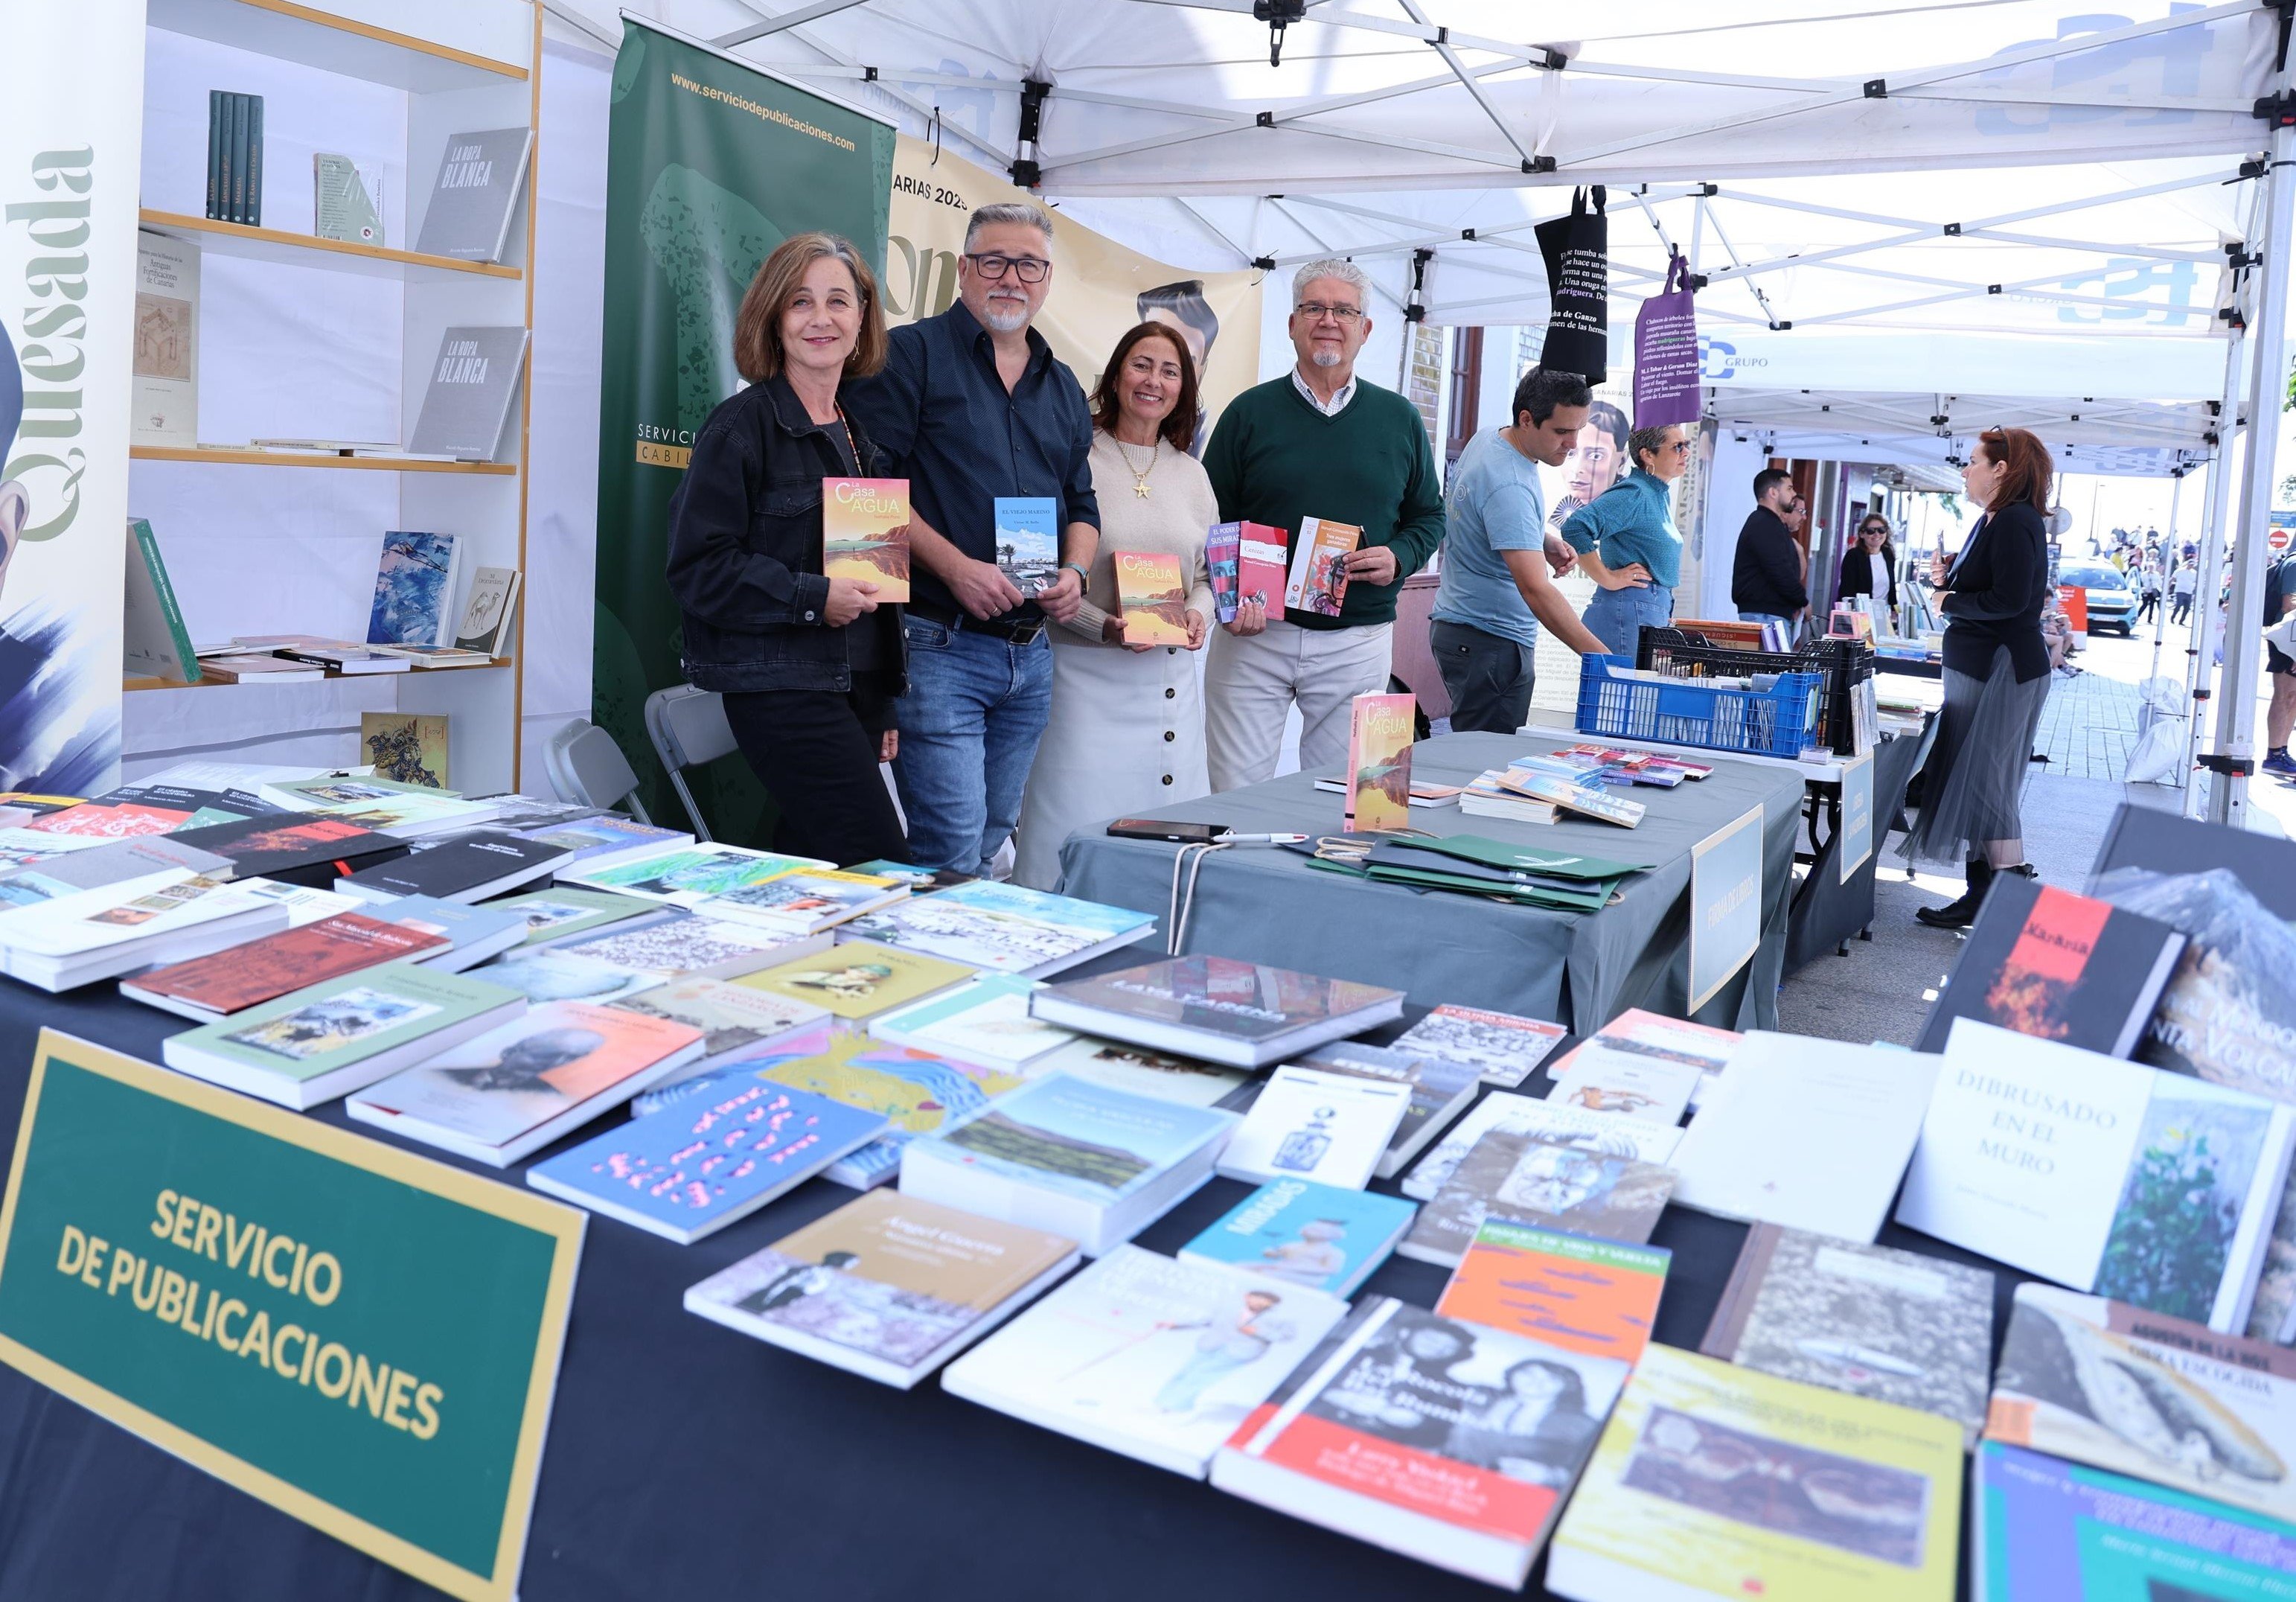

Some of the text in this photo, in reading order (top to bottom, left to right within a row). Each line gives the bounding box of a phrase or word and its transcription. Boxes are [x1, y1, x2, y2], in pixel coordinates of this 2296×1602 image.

[671, 72, 855, 152] www.serviciodepublicaciones.com
[451, 144, 482, 162] LA ROPA
[441, 161, 492, 188] BLANCA
[893, 174, 931, 200] ARIAS
[1574, 249, 1596, 258] tumba
[1565, 278, 1599, 290] Una oruga
[1574, 312, 1596, 322] Ganzo
[1578, 322, 1587, 331] las
[448, 341, 478, 356] LA ROPA
[437, 358, 488, 383] BLANCA
[1725, 357, 1768, 368] GRUPO
[639, 424, 696, 444] SERVICI
[835, 482, 875, 504] Casa
[851, 498, 901, 514] AGUA
[1220, 526, 1235, 534] PODER
[1211, 537, 1222, 545] SUS
[1136, 567, 1174, 580] AGUA
[1373, 718, 1407, 735] AGUA
[1708, 896, 1727, 930] FIRMA
[1736, 873, 1754, 907] LIBROS
[1957, 1069, 2117, 1130] DIBRUSADO
[1992, 1111, 2058, 1144] EN EL
[1977, 1137, 2056, 1175] MURO
[150, 1189, 342, 1306] SERVICIO
[57, 1225, 444, 1440] DE PUBLICACIONES
